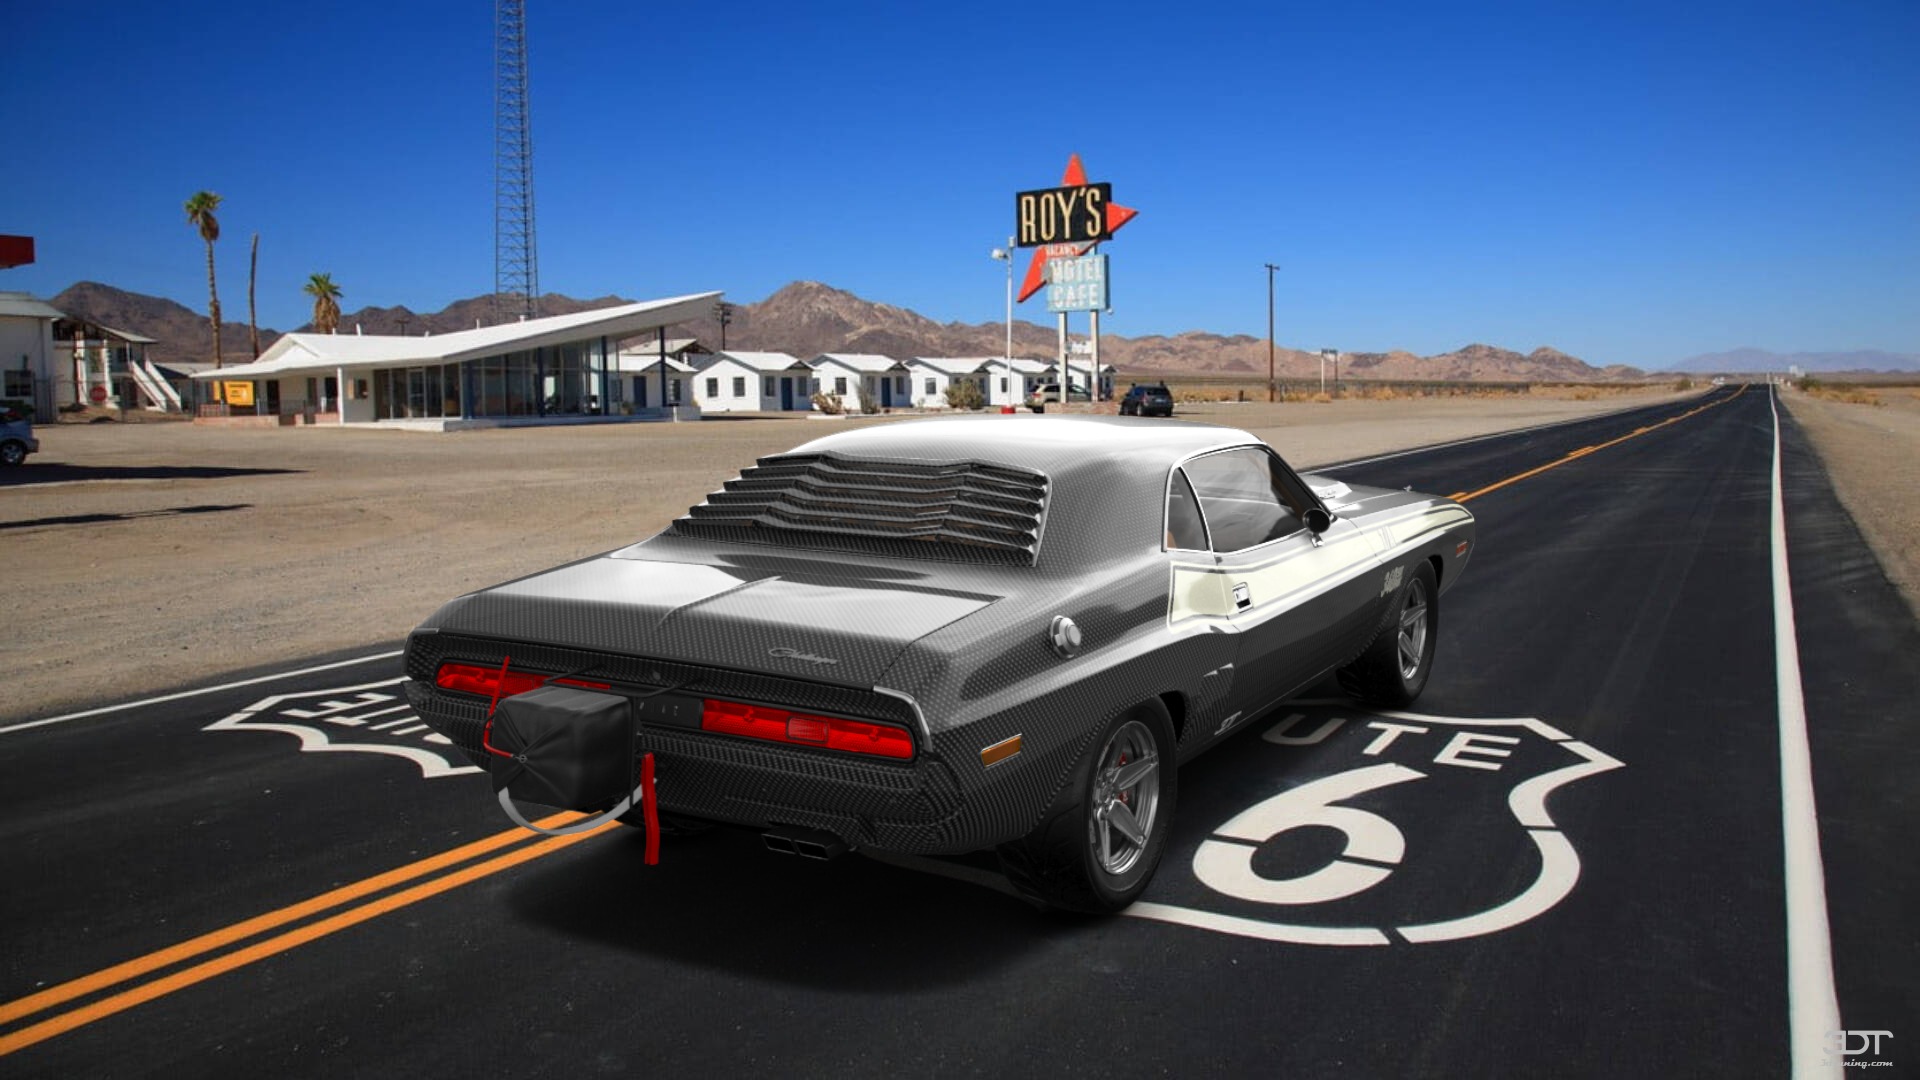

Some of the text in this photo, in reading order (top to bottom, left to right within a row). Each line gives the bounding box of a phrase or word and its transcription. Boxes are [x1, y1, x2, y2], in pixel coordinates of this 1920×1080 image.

[1021, 188, 1101, 242] ROY'S
[1050, 258, 1102, 284] MOTEL
[1053, 283, 1098, 308] CAFE
[1261, 714, 1521, 770] UTE
[1192, 762, 1428, 904] 6
